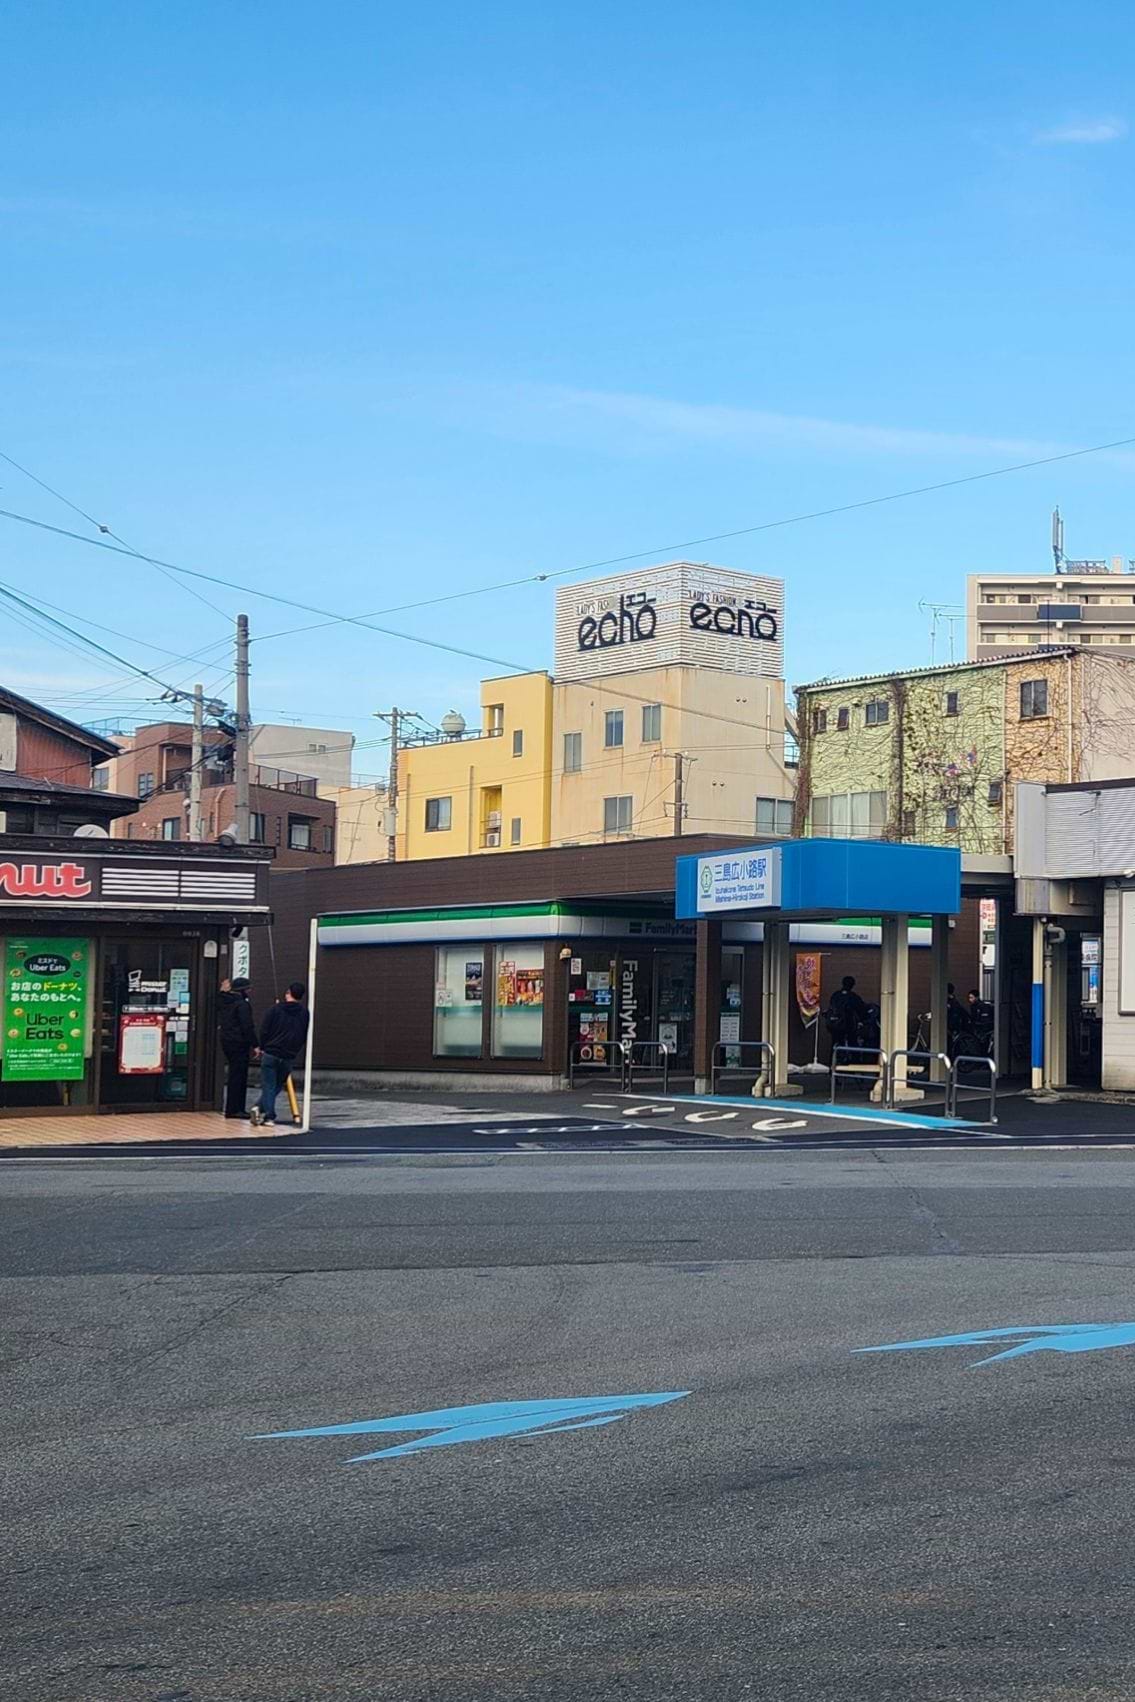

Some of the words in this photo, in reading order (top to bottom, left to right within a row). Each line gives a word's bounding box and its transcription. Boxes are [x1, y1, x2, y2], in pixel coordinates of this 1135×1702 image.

[626, 592, 657, 607] エコー
[743, 599, 778, 614] エコー
[577, 594, 658, 652] echo
[714, 858, 767, 882] 三島広小路駅
[26, 1013, 65, 1026] Uber
[25, 1027, 65, 1041] Eats
